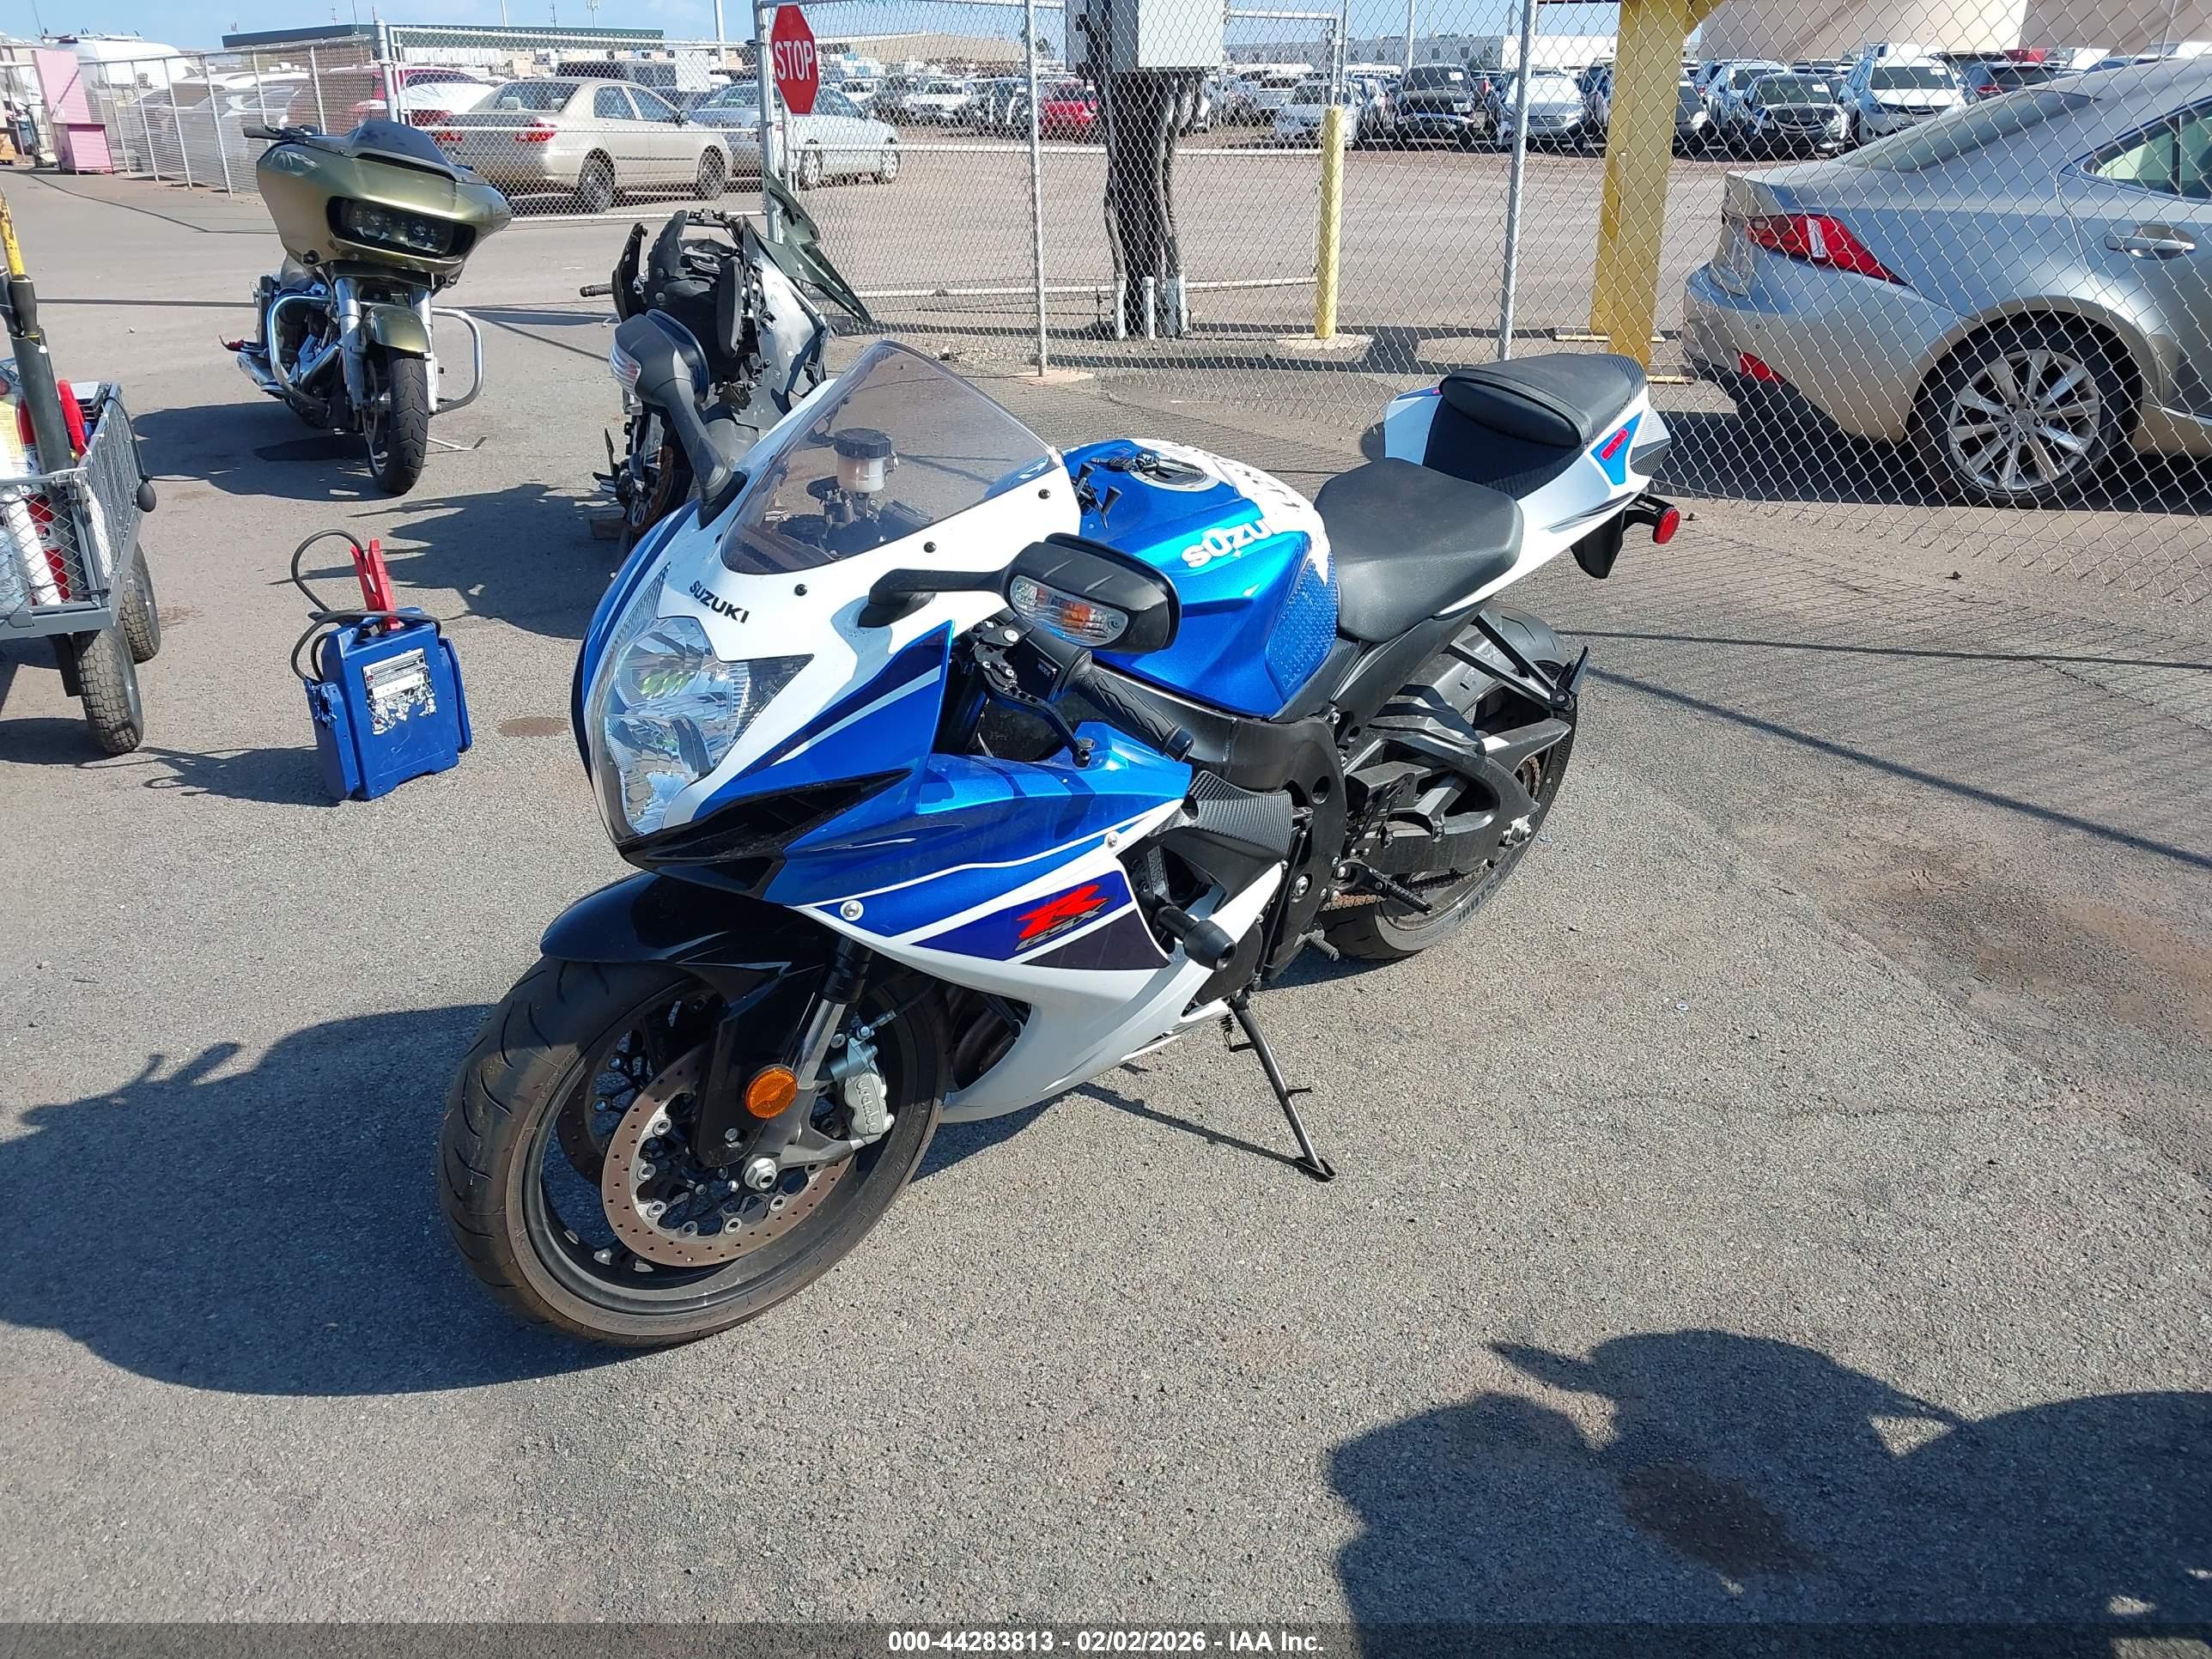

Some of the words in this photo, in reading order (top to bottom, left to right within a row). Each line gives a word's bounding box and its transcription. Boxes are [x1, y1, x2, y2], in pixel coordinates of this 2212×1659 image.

[775, 40, 814, 81] STOP
[690, 580, 750, 624] SUZUKI
[855, 1080, 880, 1133] brembo
